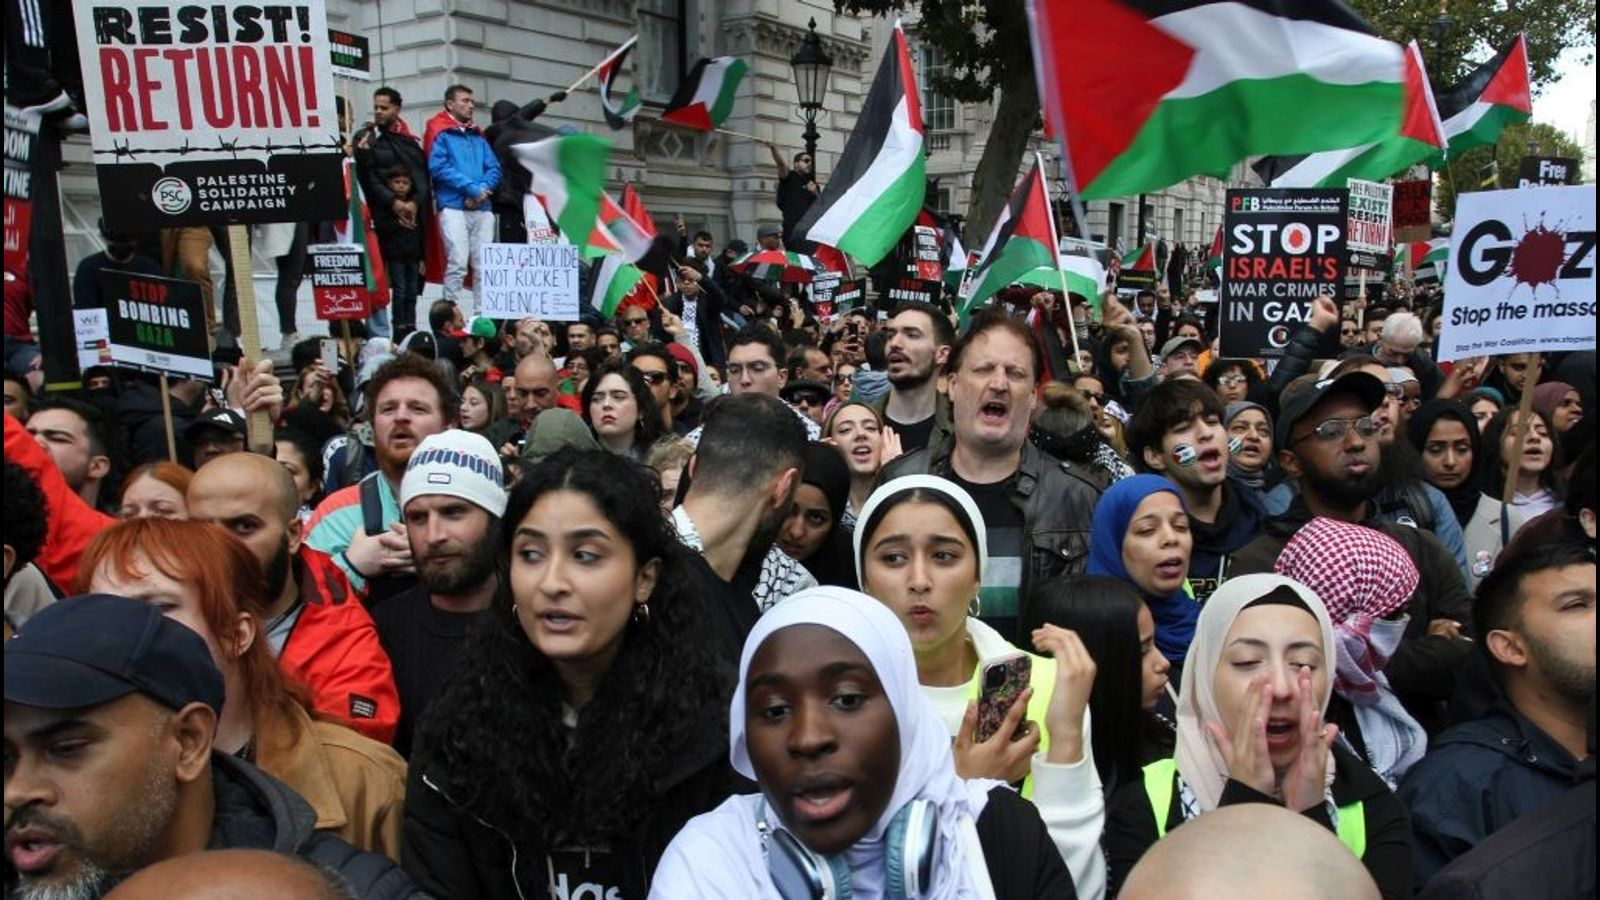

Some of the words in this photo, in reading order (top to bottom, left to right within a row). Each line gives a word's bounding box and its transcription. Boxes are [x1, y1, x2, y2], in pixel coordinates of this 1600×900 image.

[93, 5, 311, 45] RESIST!
[99, 46, 321, 132] RETURN!
[196, 174, 286, 187] PALESTINE
[160, 189, 184, 202] PSC
[198, 185, 297, 199] SOLIDARITY
[200, 198, 287, 211] CAMPAIGN
[1231, 196, 1260, 212] PFB
[1349, 196, 1389, 213] EXIST!
[1348, 209, 1388, 224] RESIST!
[1231, 222, 1340, 255] STOP
[1347, 218, 1387, 246] RETURN!
[314, 255, 360, 268] FREEDOM
[506, 247, 516, 265] A
[518, 247, 578, 269] GENOCIDE
[1229, 256, 1337, 279] ISRAEL'S
[314, 272, 364, 286] PALESTINE
[484, 269, 508, 288] NOT
[515, 269, 572, 288] ROCKET
[129, 280, 168, 305] STOP
[1228, 282, 1268, 297] WAR
[1273, 282, 1336, 298] CRIMES
[118, 298, 191, 329] BOMBING
[486, 291, 549, 315] SCIENCE
[1228, 301, 1254, 322] IN
[1262, 301, 1314, 323] GAZ
[1451, 306, 1491, 327] Stop
[1496, 301, 1527, 321] the
[137, 322, 175, 348] GAZA
